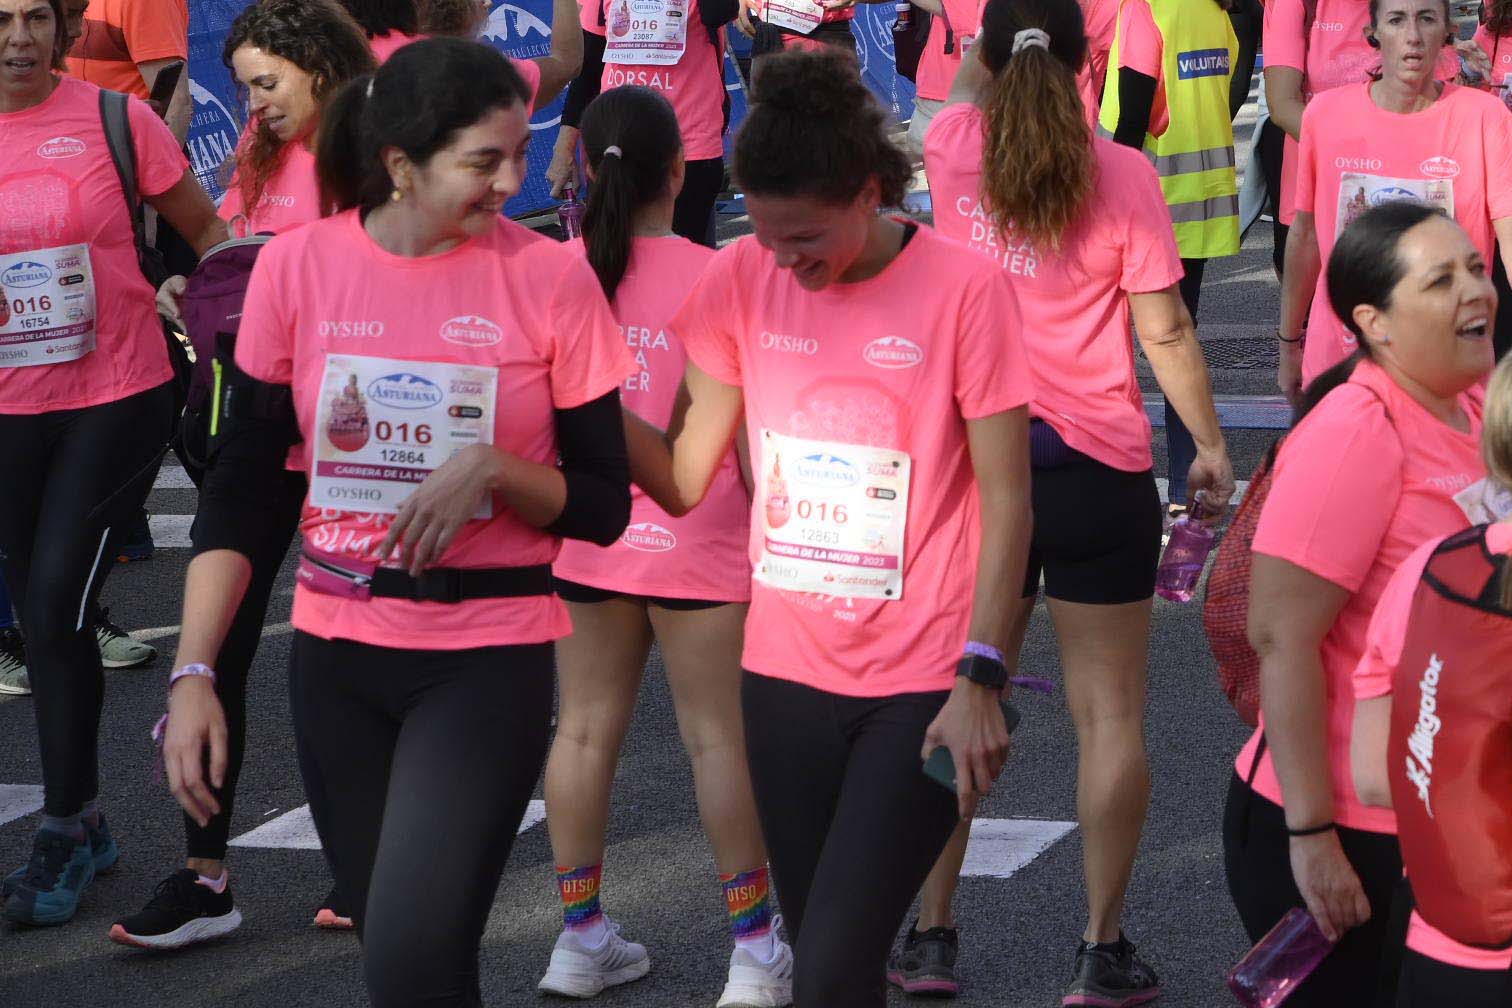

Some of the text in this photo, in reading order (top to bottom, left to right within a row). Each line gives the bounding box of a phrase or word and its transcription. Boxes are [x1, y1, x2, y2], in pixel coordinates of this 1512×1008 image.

[631, 19, 658, 31] 016
[607, 68, 673, 90] DORSAL
[1335, 156, 1383, 171] OYSHO
[4, 270, 49, 285] ASTURIANA
[13, 294, 52, 315] 016
[20, 316, 50, 329] 16754
[318, 320, 385, 338] OYSHO
[760, 331, 819, 356] OYSHO
[867, 347, 919, 363] ASTURIANA
[372, 385, 438, 403] ASTURIANA
[375, 420, 433, 444] 016
[380, 448, 426, 465] 12864
[334, 465, 413, 480] CARRERA DE LA
[797, 465, 855, 483] ASTURIANA
[327, 485, 383, 501] OYSHO
[797, 499, 848, 525] 016
[623, 532, 672, 548] ASTURIANA
[800, 527, 840, 545] 12863
[801, 547, 815, 559] DE
[816, 549, 828, 560] LA
[829, 550, 861, 565] MUJER
[837, 573, 888, 587] Santander
[563, 877, 757, 903] OTSO OTSO
